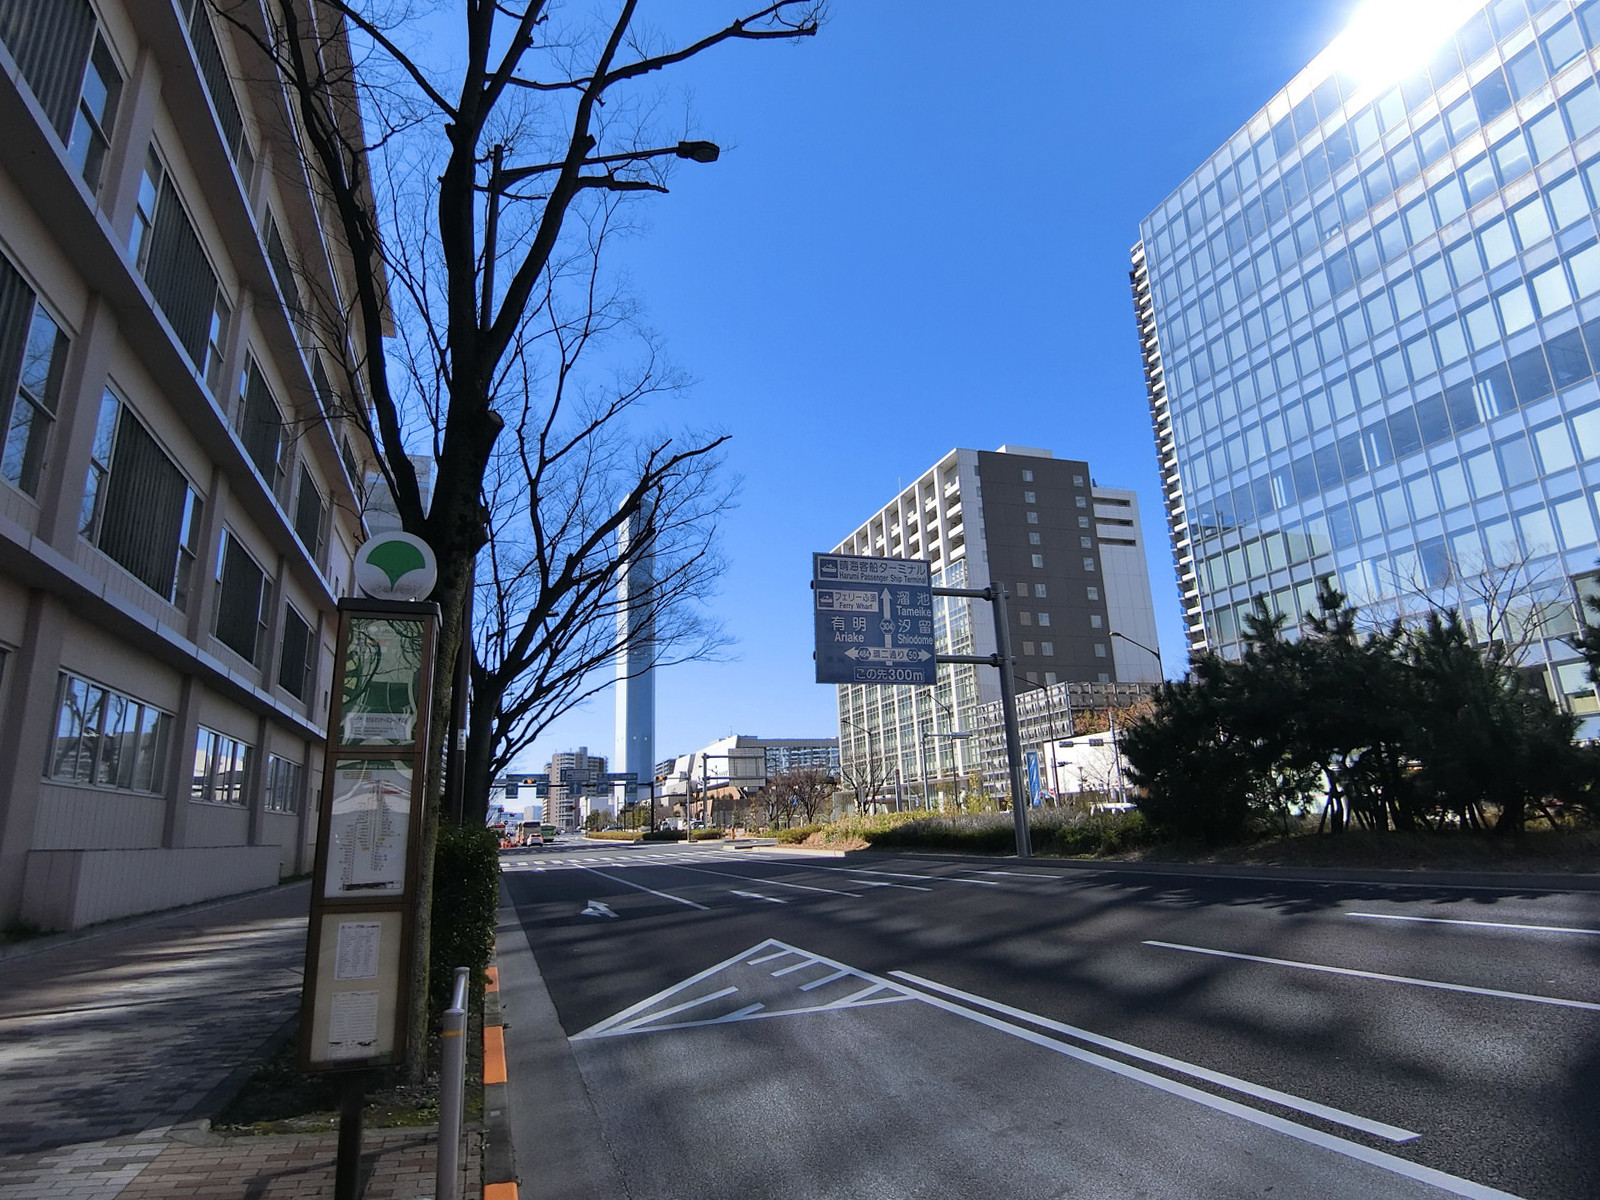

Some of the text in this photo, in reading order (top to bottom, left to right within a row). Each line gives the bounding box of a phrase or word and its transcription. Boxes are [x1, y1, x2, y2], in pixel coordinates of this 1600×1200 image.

[840, 560, 926, 576] 晴海客船ターミナル
[840, 572, 926, 584] Harumi Passenger Ship Terminal
[835, 592, 876, 602] フェリーふ頭
[896, 591, 930, 606] 溜池
[896, 606, 932, 617] Tameike
[831, 616, 866, 632] 有明
[881, 622, 893, 631] 304
[898, 620, 931, 634] 汐留
[834, 632, 864, 642] Ariake
[898, 634, 934, 645] Shiodome
[873, 650, 904, 660] 環二通り
[908, 652, 918, 660] 50
[856, 668, 923, 681] この先300m
